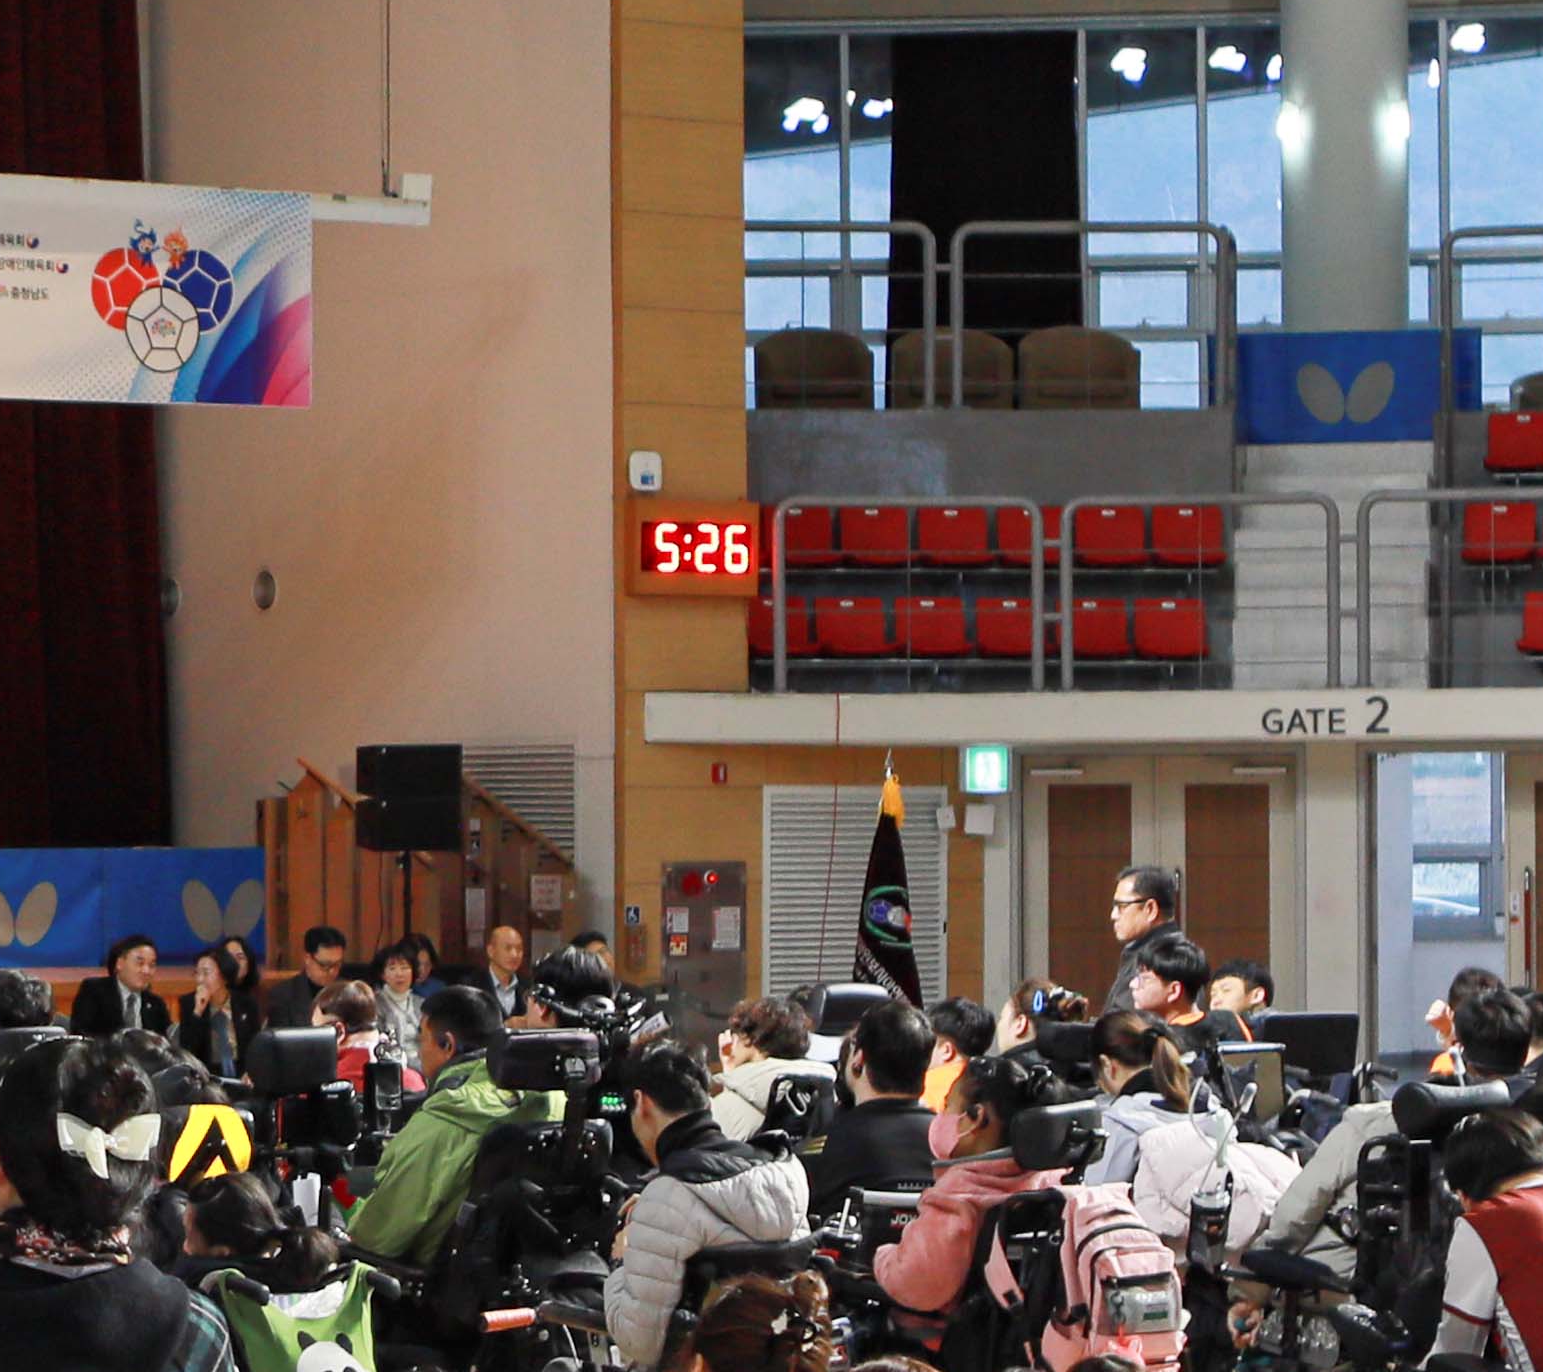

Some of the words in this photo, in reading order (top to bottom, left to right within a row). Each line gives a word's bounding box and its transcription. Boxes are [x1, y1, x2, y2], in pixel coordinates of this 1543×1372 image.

[655, 522, 749, 574] 5:26
[1262, 708, 1345, 734] GATE
[1365, 695, 1390, 734] 2
